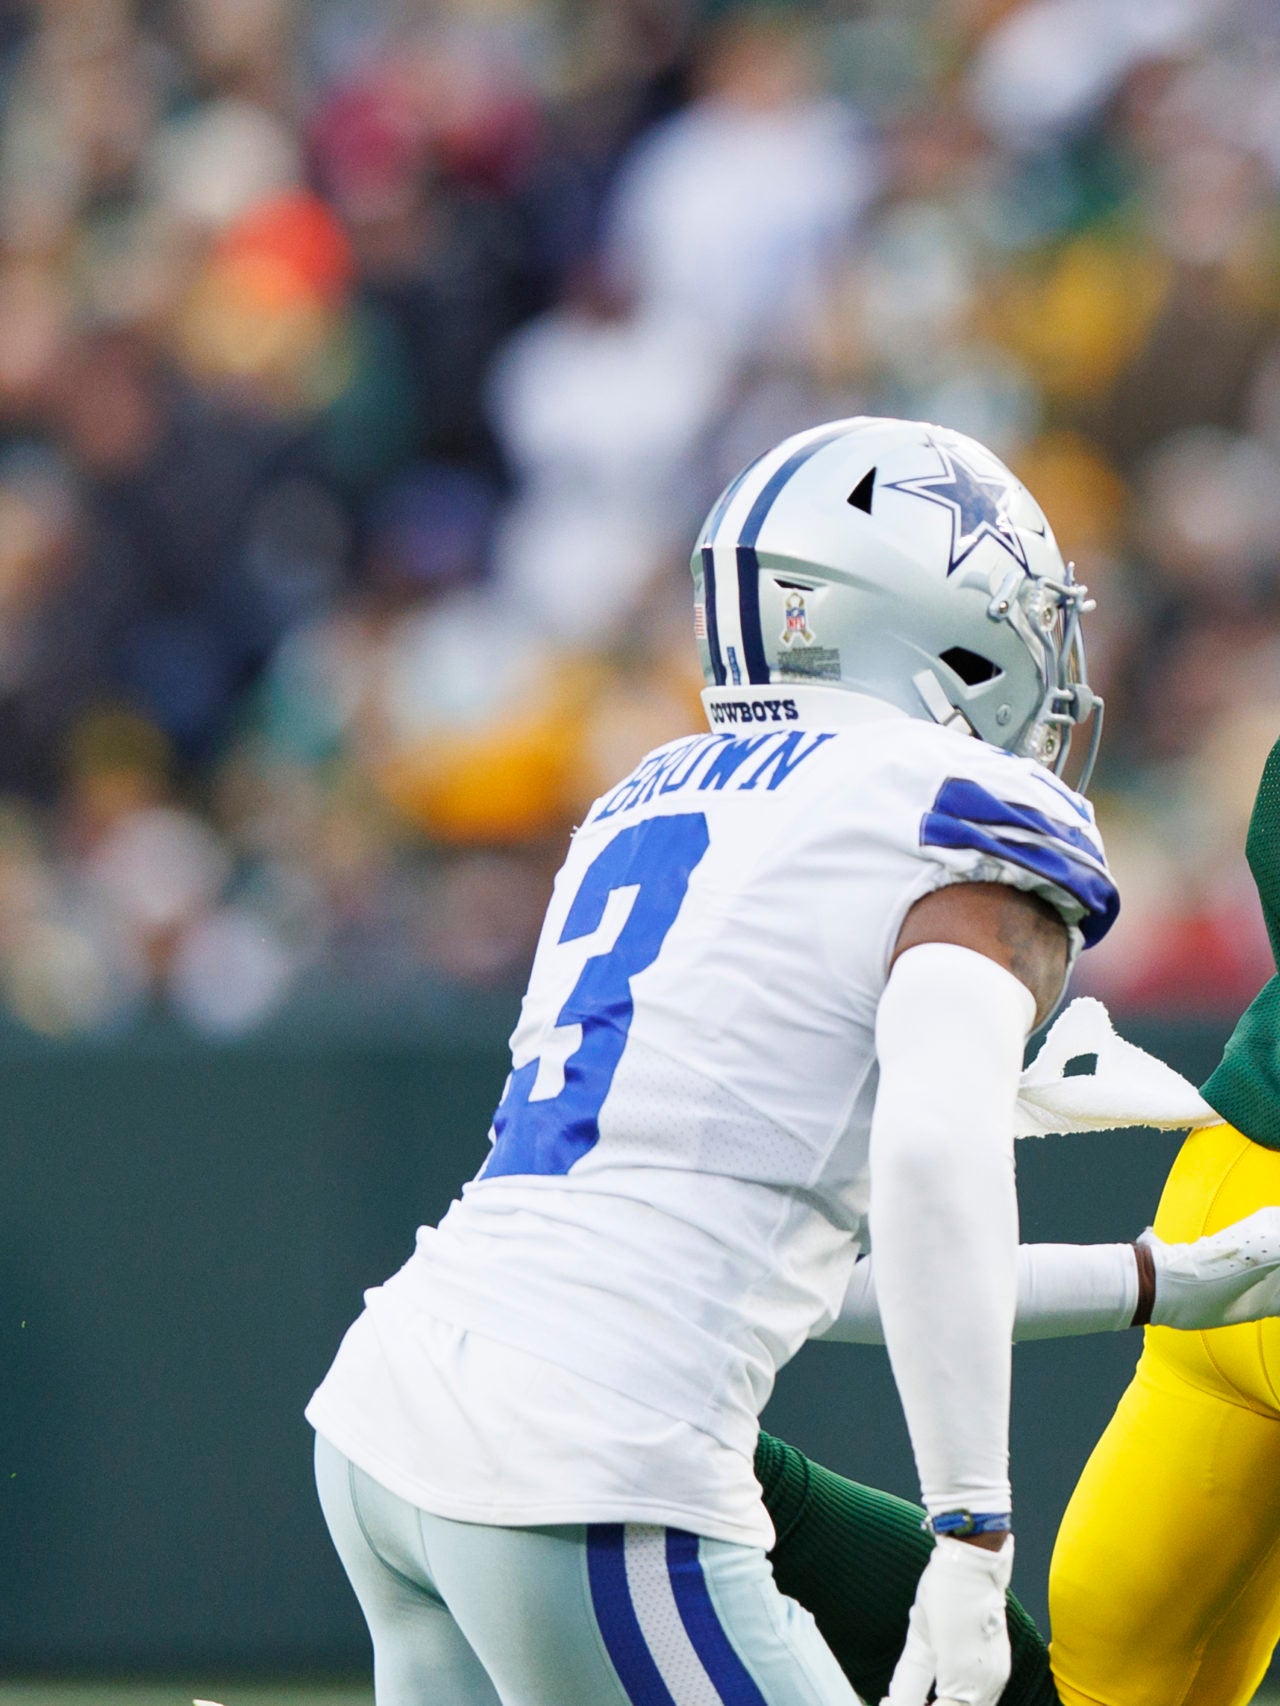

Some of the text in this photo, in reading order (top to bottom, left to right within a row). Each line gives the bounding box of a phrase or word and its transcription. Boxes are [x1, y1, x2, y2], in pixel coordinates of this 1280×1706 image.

[709, 699, 799, 724] COWBOYS
[592, 730, 839, 824] BROWN
[478, 811, 710, 1182] 3
